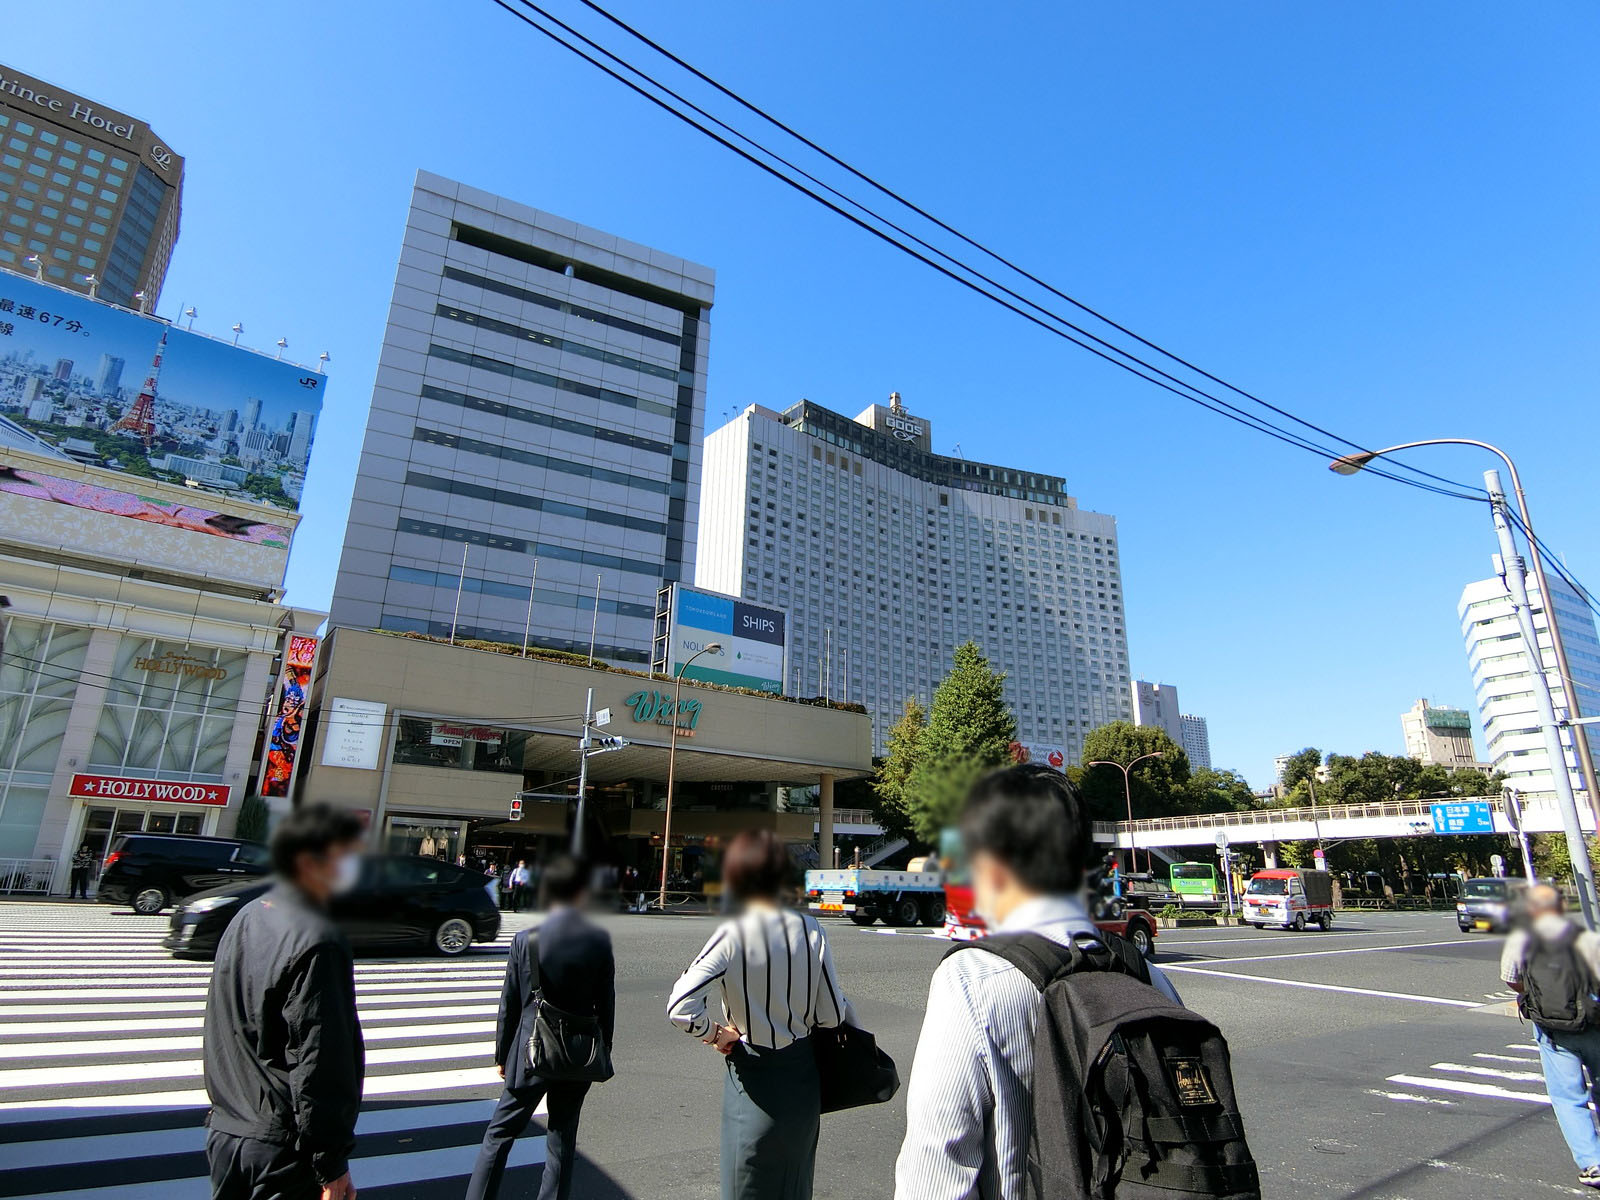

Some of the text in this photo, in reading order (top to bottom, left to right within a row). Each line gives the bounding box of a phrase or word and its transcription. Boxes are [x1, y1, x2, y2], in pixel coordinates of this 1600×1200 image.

[0, 73, 135, 140] rince Hotel
[299, 377, 318, 388] JR
[743, 615, 775, 633] SHIPS
[134, 656, 227, 680] HOLLYWOOD
[625, 690, 703, 730] Wing
[97, 780, 206, 801] HOLLYWOOD
